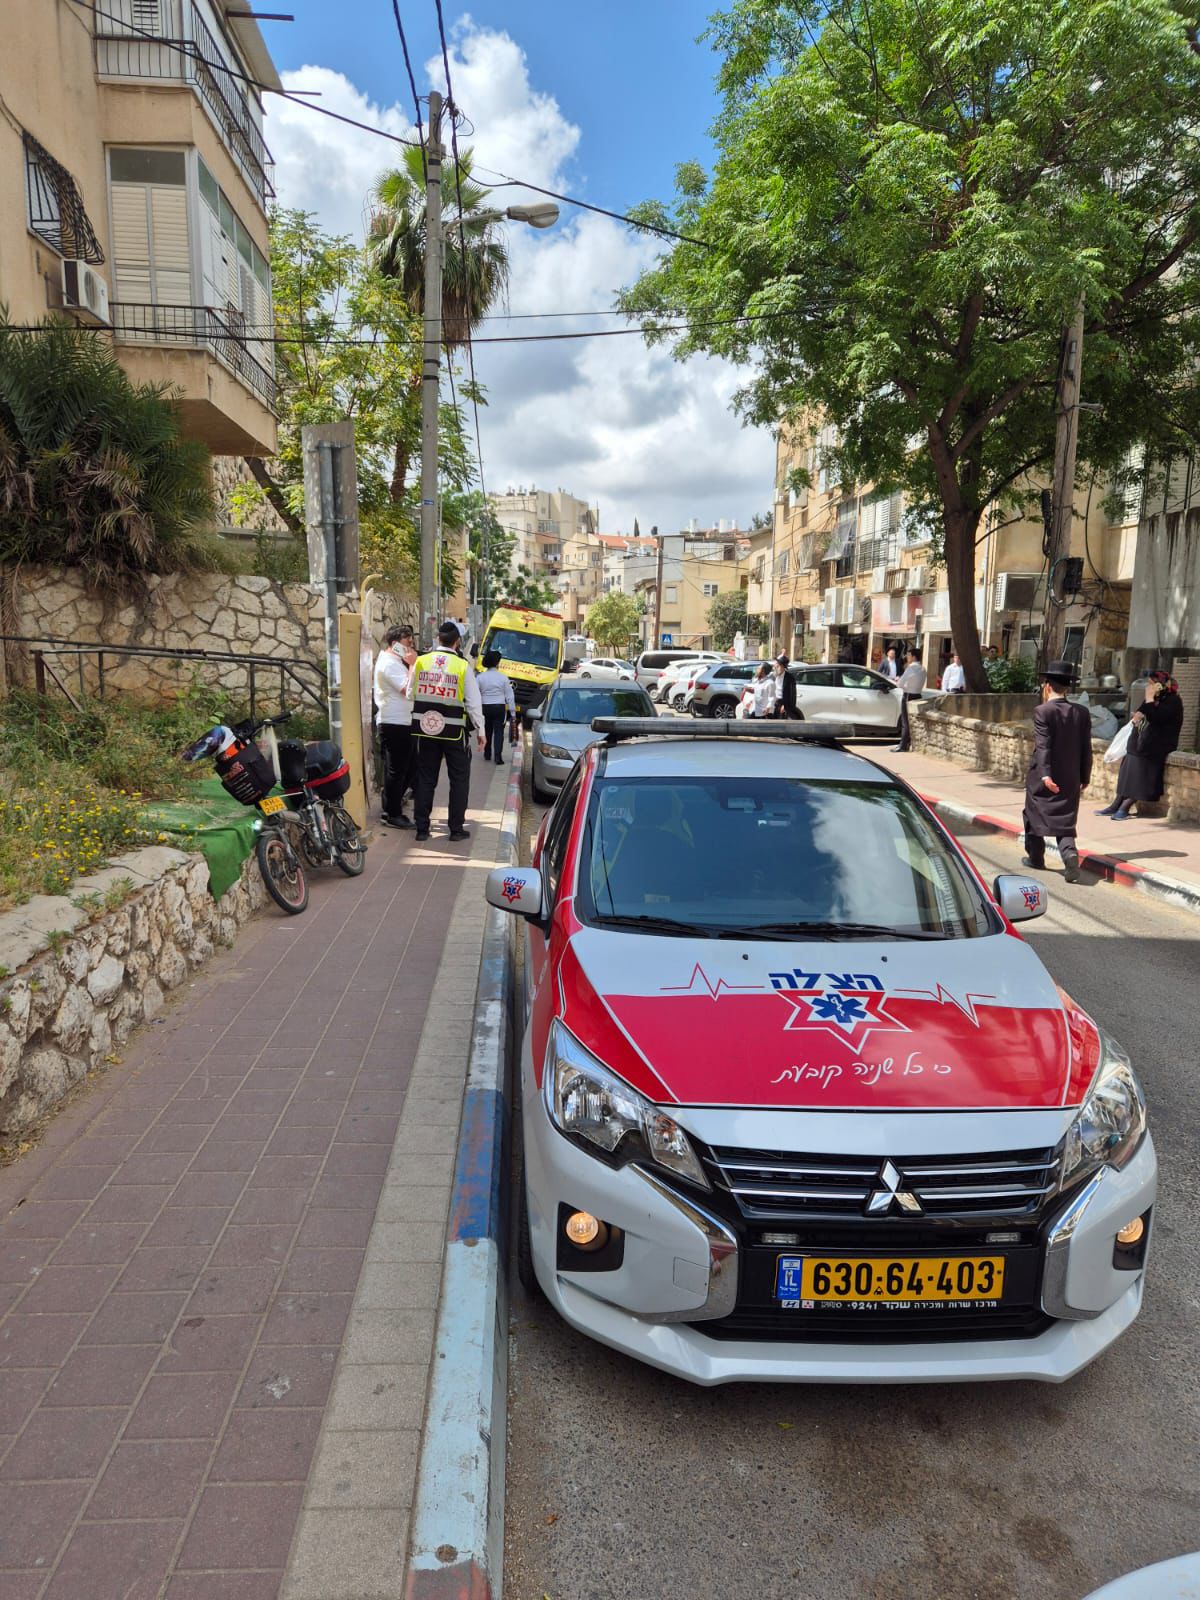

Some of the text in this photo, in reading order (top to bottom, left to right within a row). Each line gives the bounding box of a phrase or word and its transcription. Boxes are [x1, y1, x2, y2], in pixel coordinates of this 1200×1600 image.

[418, 684, 457, 698] הצלה
[768, 968, 885, 991] הצלה
[770, 1051, 952, 1090] כי כל שניה קובעת
[881, 1301, 911, 1310] שקד
[948, 1301, 971, 1309] שרות
[974, 1300, 997, 1308] מרכז
